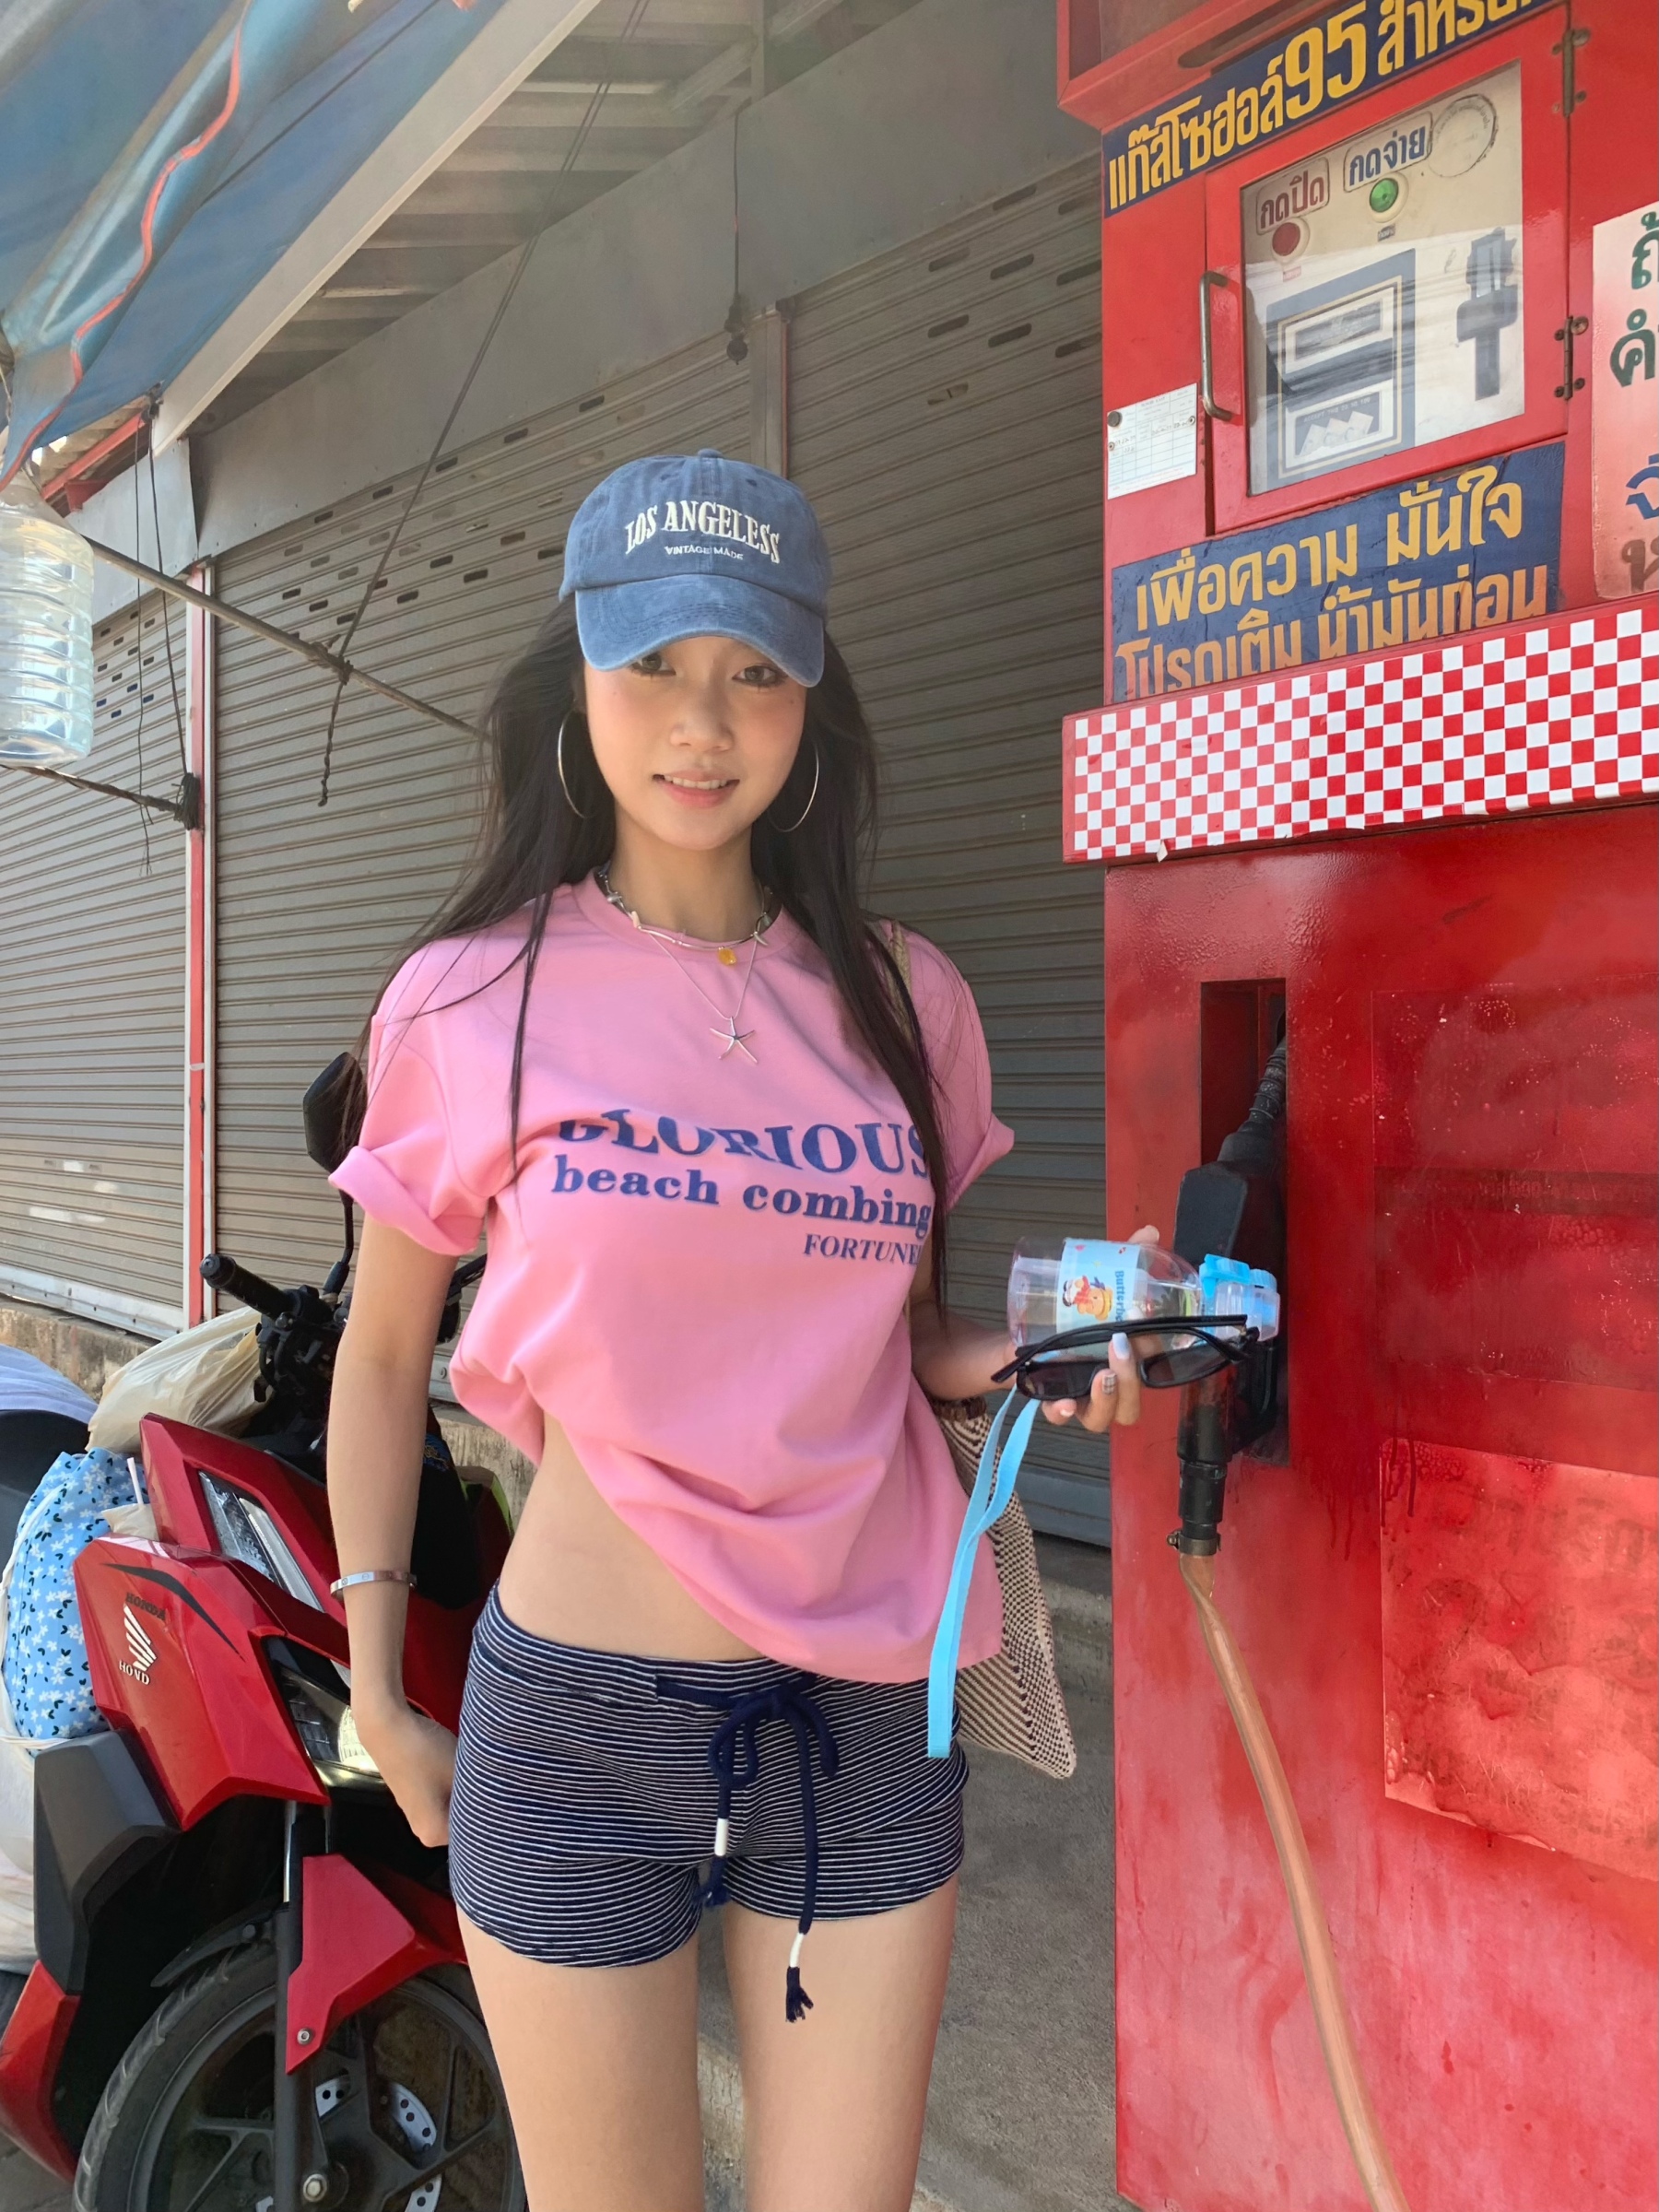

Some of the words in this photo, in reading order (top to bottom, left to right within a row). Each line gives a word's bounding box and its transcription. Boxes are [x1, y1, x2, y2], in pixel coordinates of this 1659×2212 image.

[1348, 125, 1426, 186] กดจ่าย
[1260, 170, 1324, 229] กดปิด
[625, 504, 658, 555] LOS
[661, 500, 781, 564] ANGELESS
[664, 545, 711, 555] VINTAGE
[713, 547, 744, 560] MADE
[1136, 524, 1358, 631] เพื่อความ
[1387, 465, 1523, 566] มั่นใจ
[551, 1154, 720, 1205] beach
[742, 1185, 932, 1240] combing
[124, 1592, 167, 1621] HONDA
